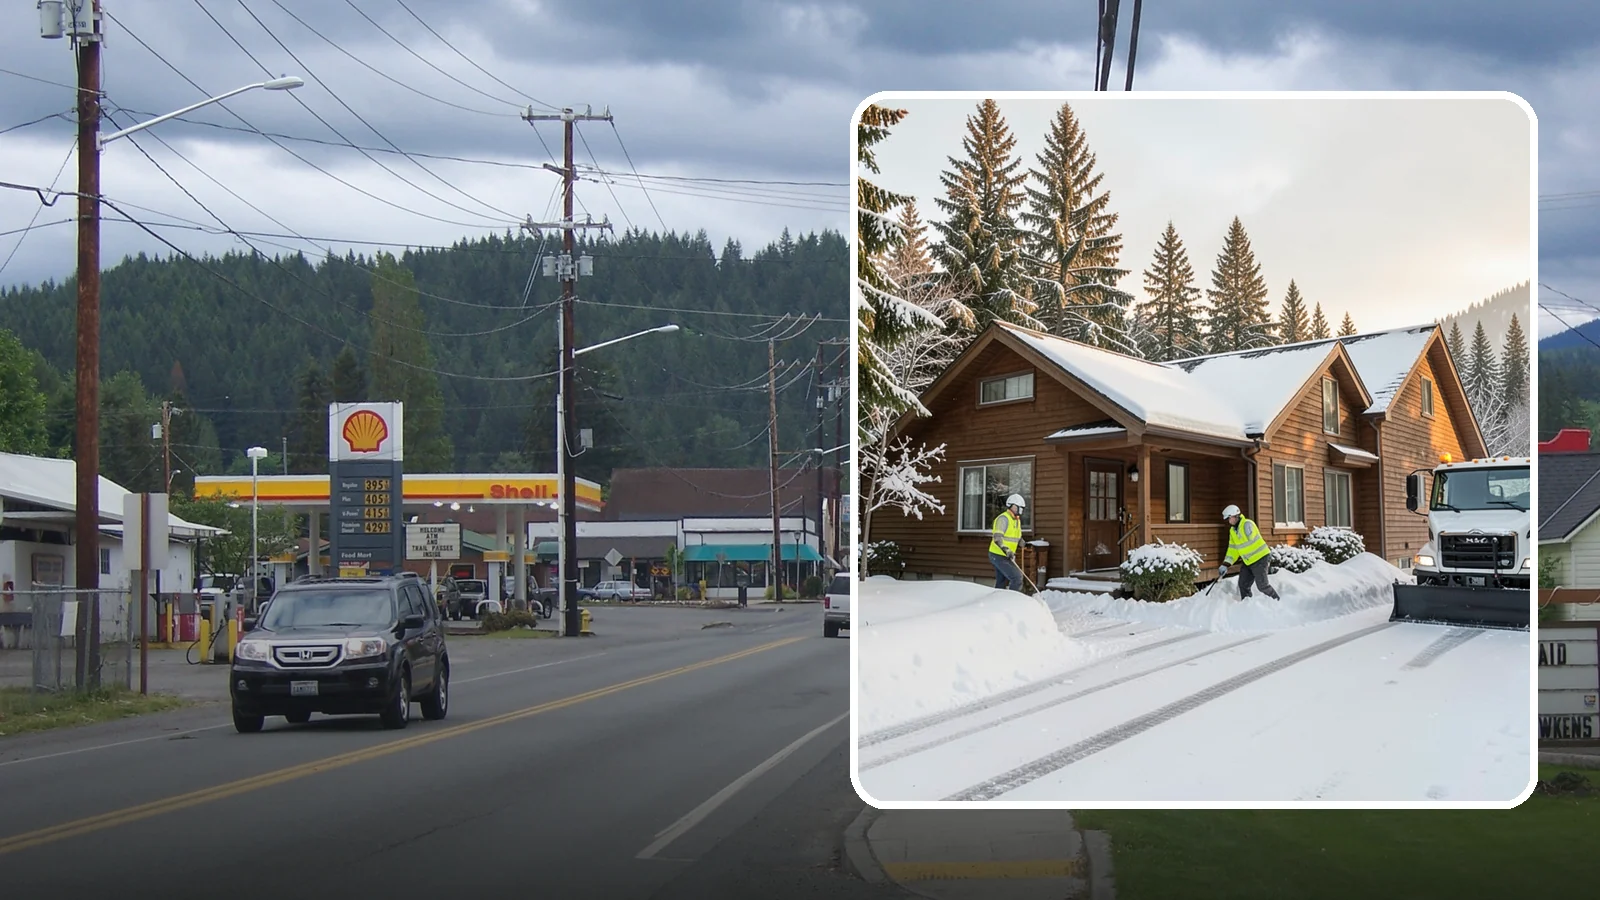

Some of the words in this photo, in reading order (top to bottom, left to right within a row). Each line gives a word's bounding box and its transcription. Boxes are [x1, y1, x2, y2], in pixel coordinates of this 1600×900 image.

[366, 480, 383, 490] 395
[490, 484, 547, 498] Shell
[366, 494, 384, 504] 405
[366, 508, 383, 518] 415
[366, 522, 384, 532] 429
